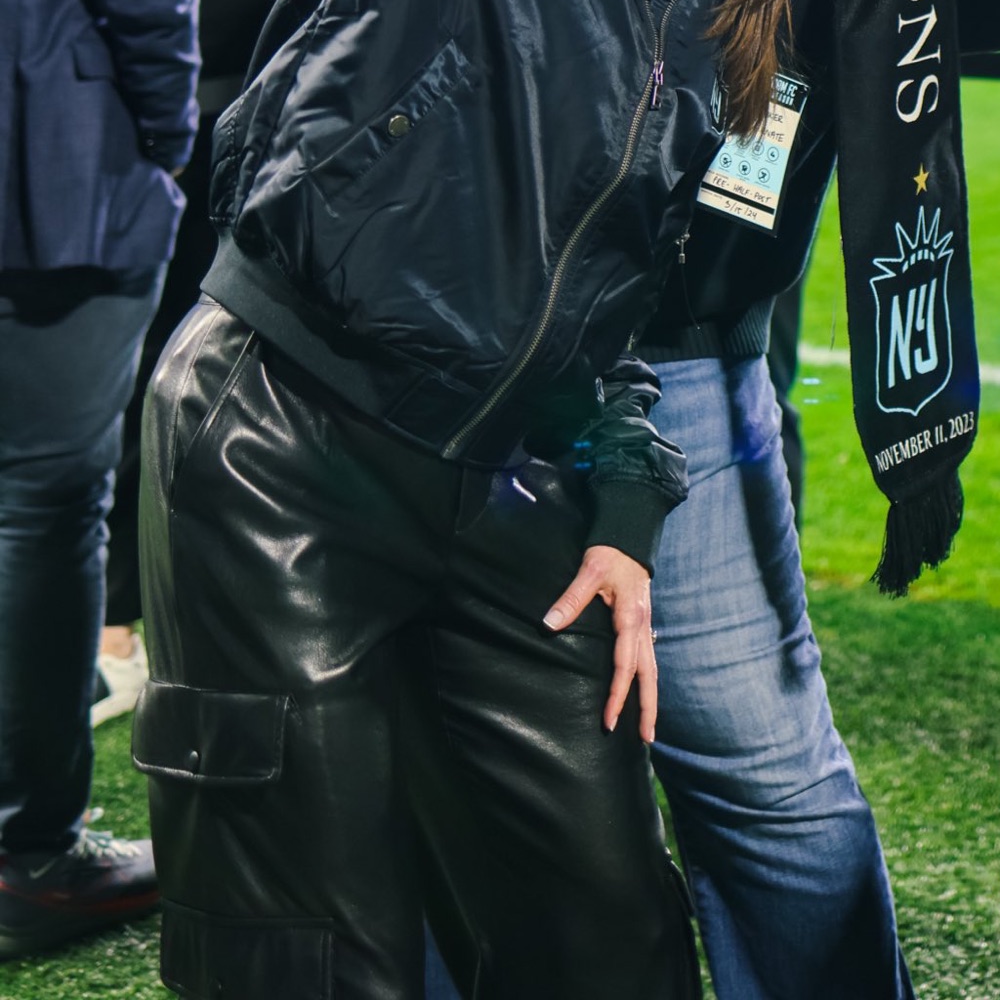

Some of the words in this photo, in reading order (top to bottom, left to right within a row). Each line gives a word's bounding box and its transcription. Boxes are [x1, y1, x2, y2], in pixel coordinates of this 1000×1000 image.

[888, 278, 938, 388] NY
[875, 429, 933, 474] NOVEMBER
[948, 411, 974, 439] 2023
